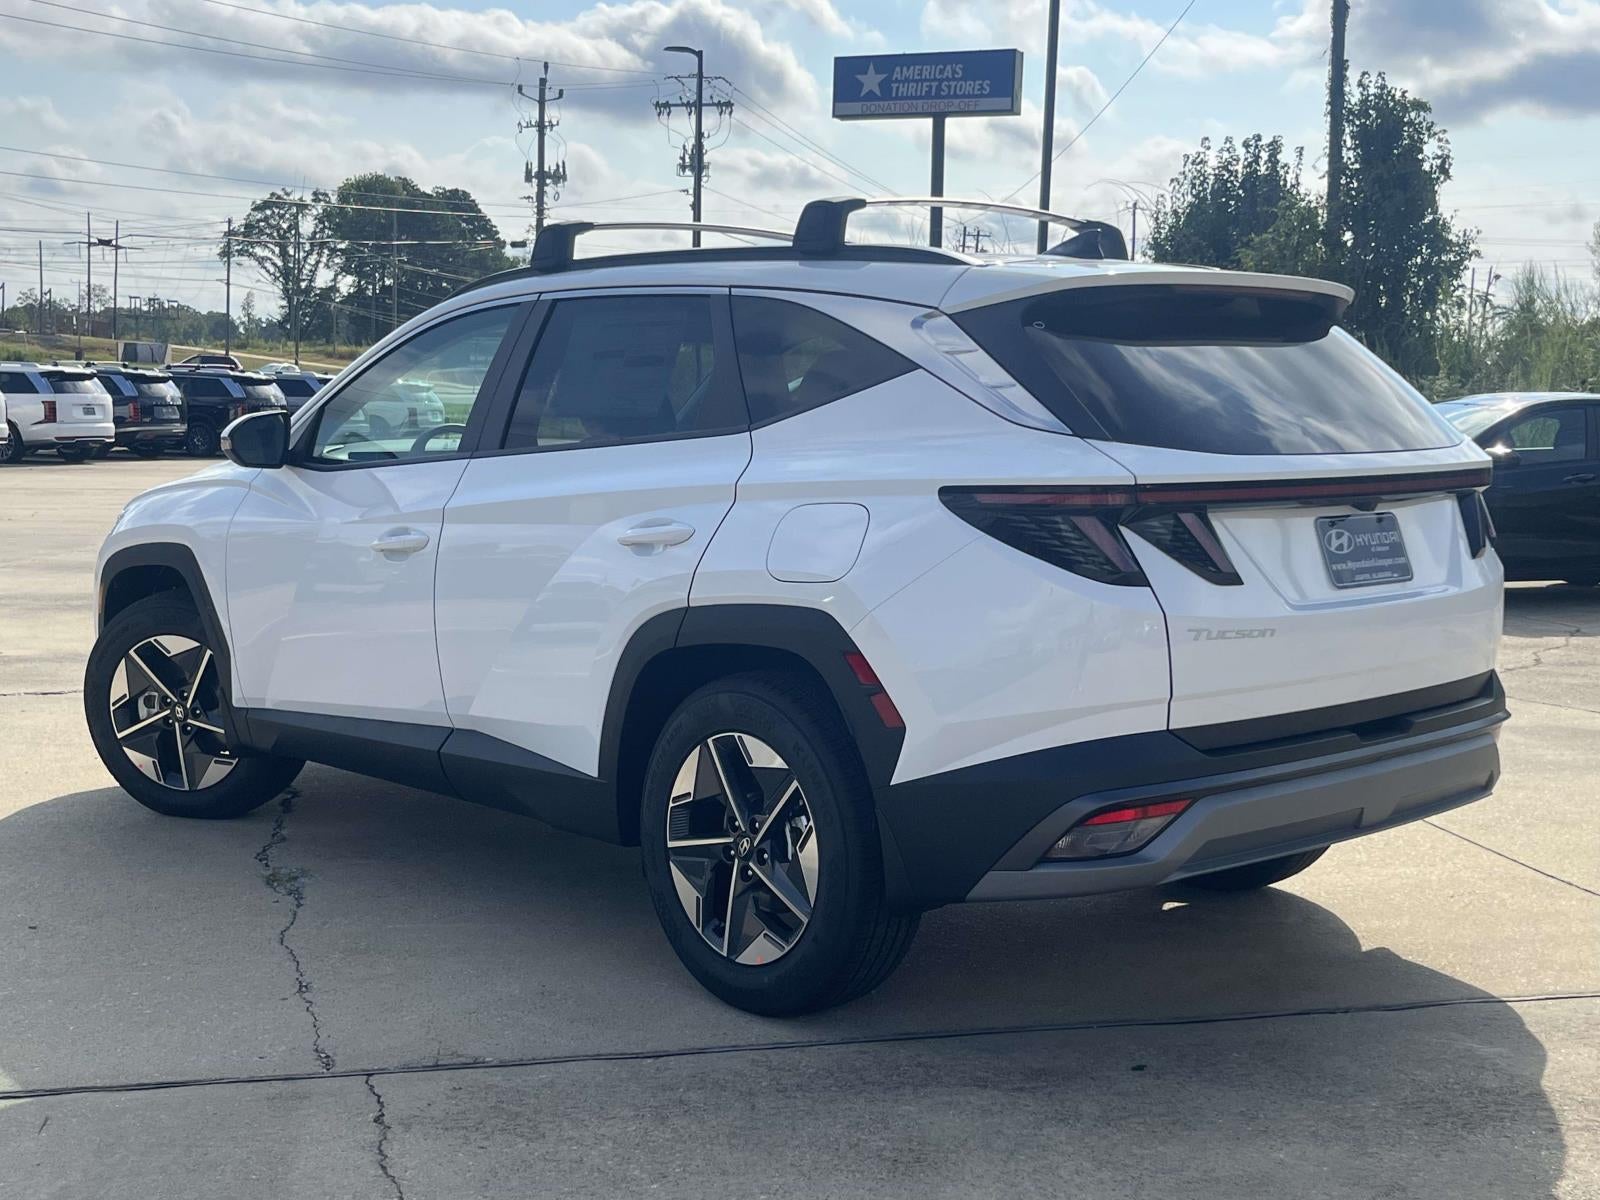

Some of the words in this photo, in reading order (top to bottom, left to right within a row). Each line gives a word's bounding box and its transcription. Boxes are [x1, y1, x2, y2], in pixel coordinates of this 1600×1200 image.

[892, 64, 964, 81] AMERICA'S
[891, 82, 938, 98] THRIFT
[939, 80, 991, 96] STORES
[861, 102, 919, 114] DONATION
[1354, 531, 1401, 546] HYUNDAI
